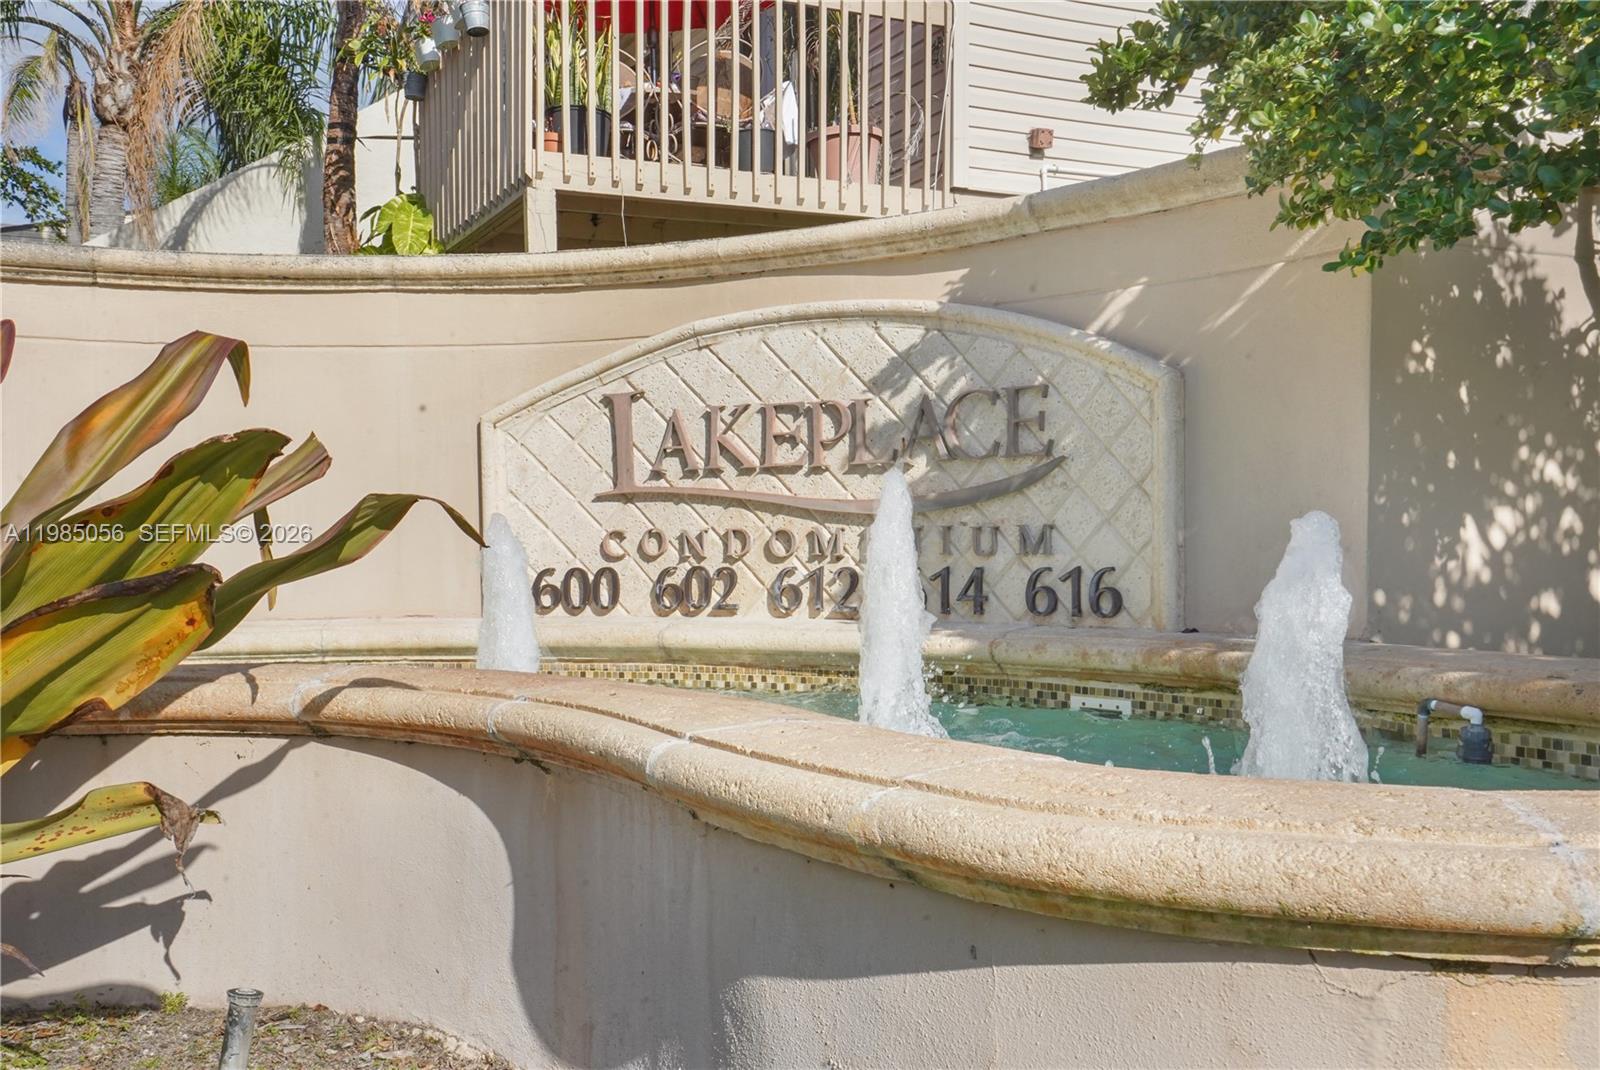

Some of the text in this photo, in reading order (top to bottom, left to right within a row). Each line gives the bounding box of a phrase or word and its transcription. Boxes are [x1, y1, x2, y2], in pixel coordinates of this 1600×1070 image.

[597, 385, 1053, 493] LAKEPLACE
[601, 524, 1056, 561] CONDOMIUM
[532, 565, 1123, 618] 600 602 612 14 616
